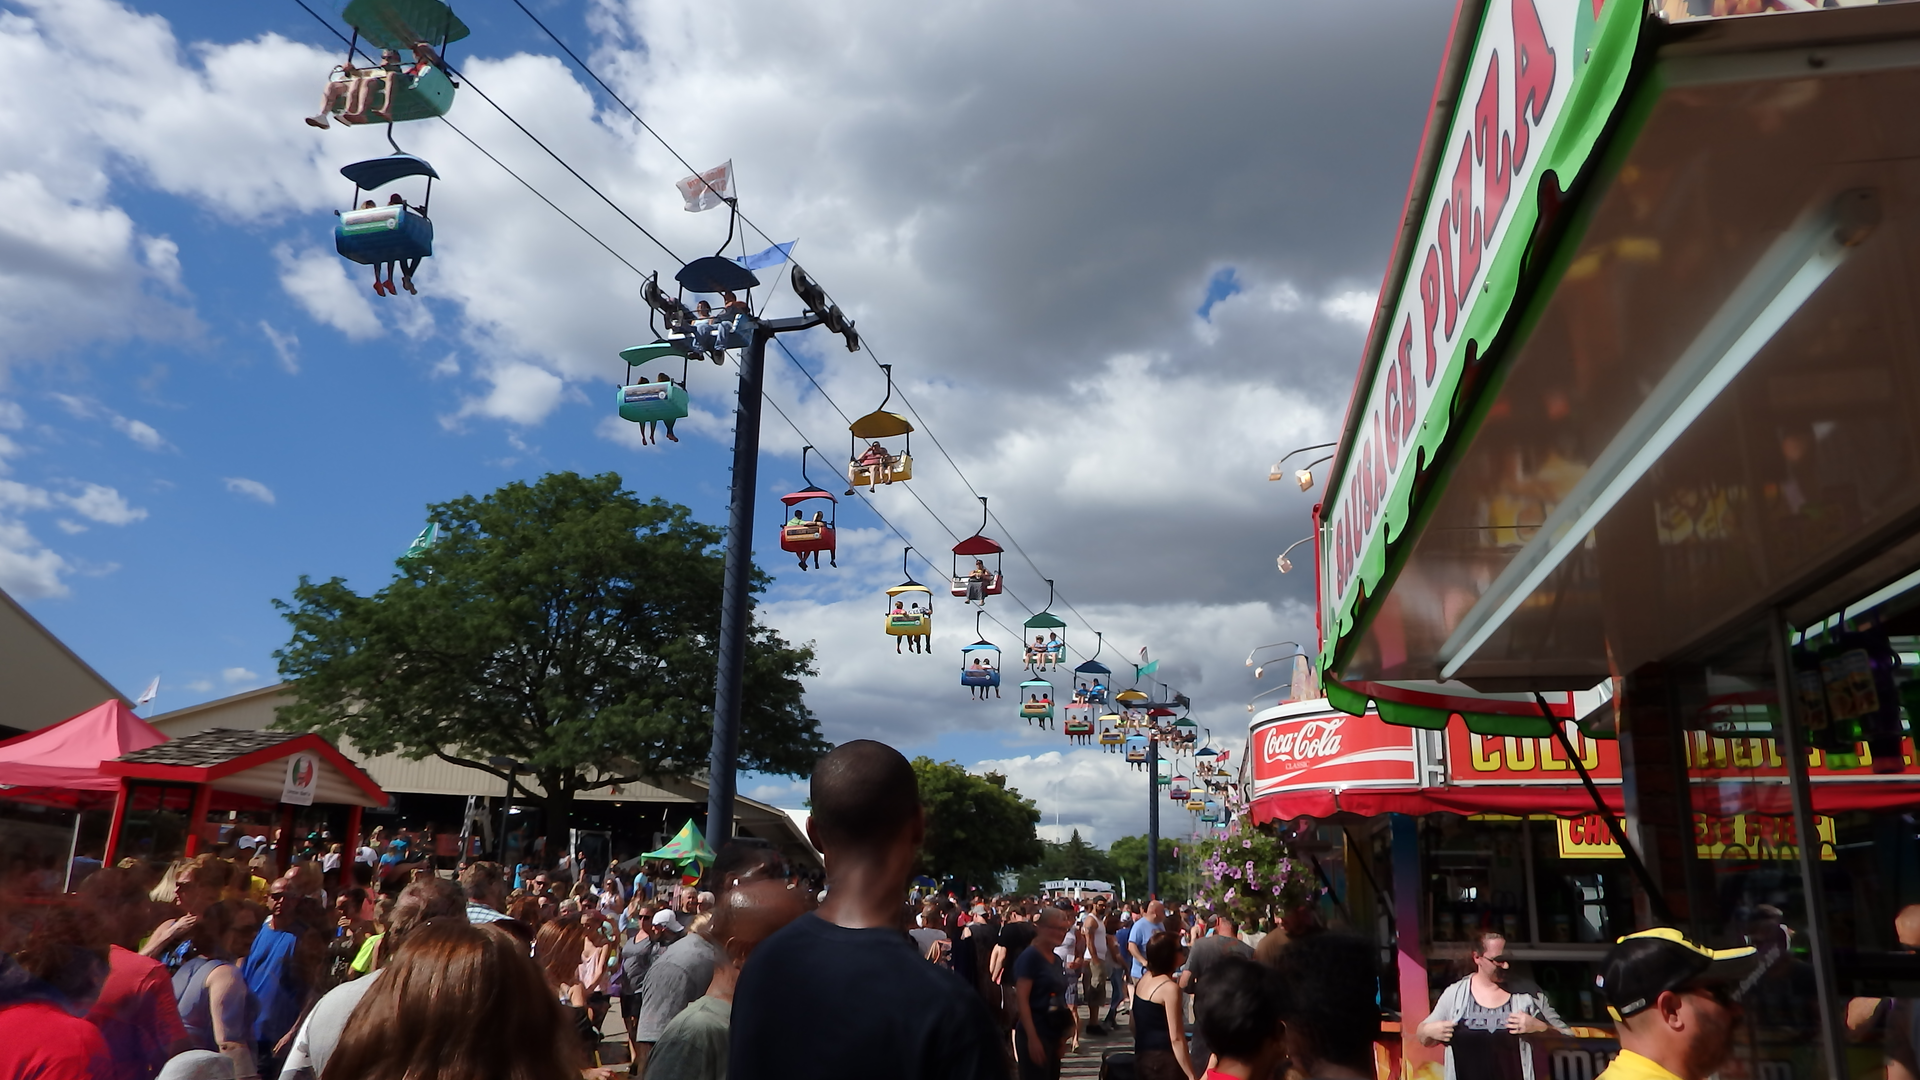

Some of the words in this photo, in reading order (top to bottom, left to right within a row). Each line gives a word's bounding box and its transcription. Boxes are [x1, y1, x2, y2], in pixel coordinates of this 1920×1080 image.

[1336, 312, 1416, 600] SAUSAGE
[1420, 0, 1556, 389] PIZZA
[1264, 718, 1346, 764] Coca-Cola
[1285, 761, 1310, 771] CLASSIC
